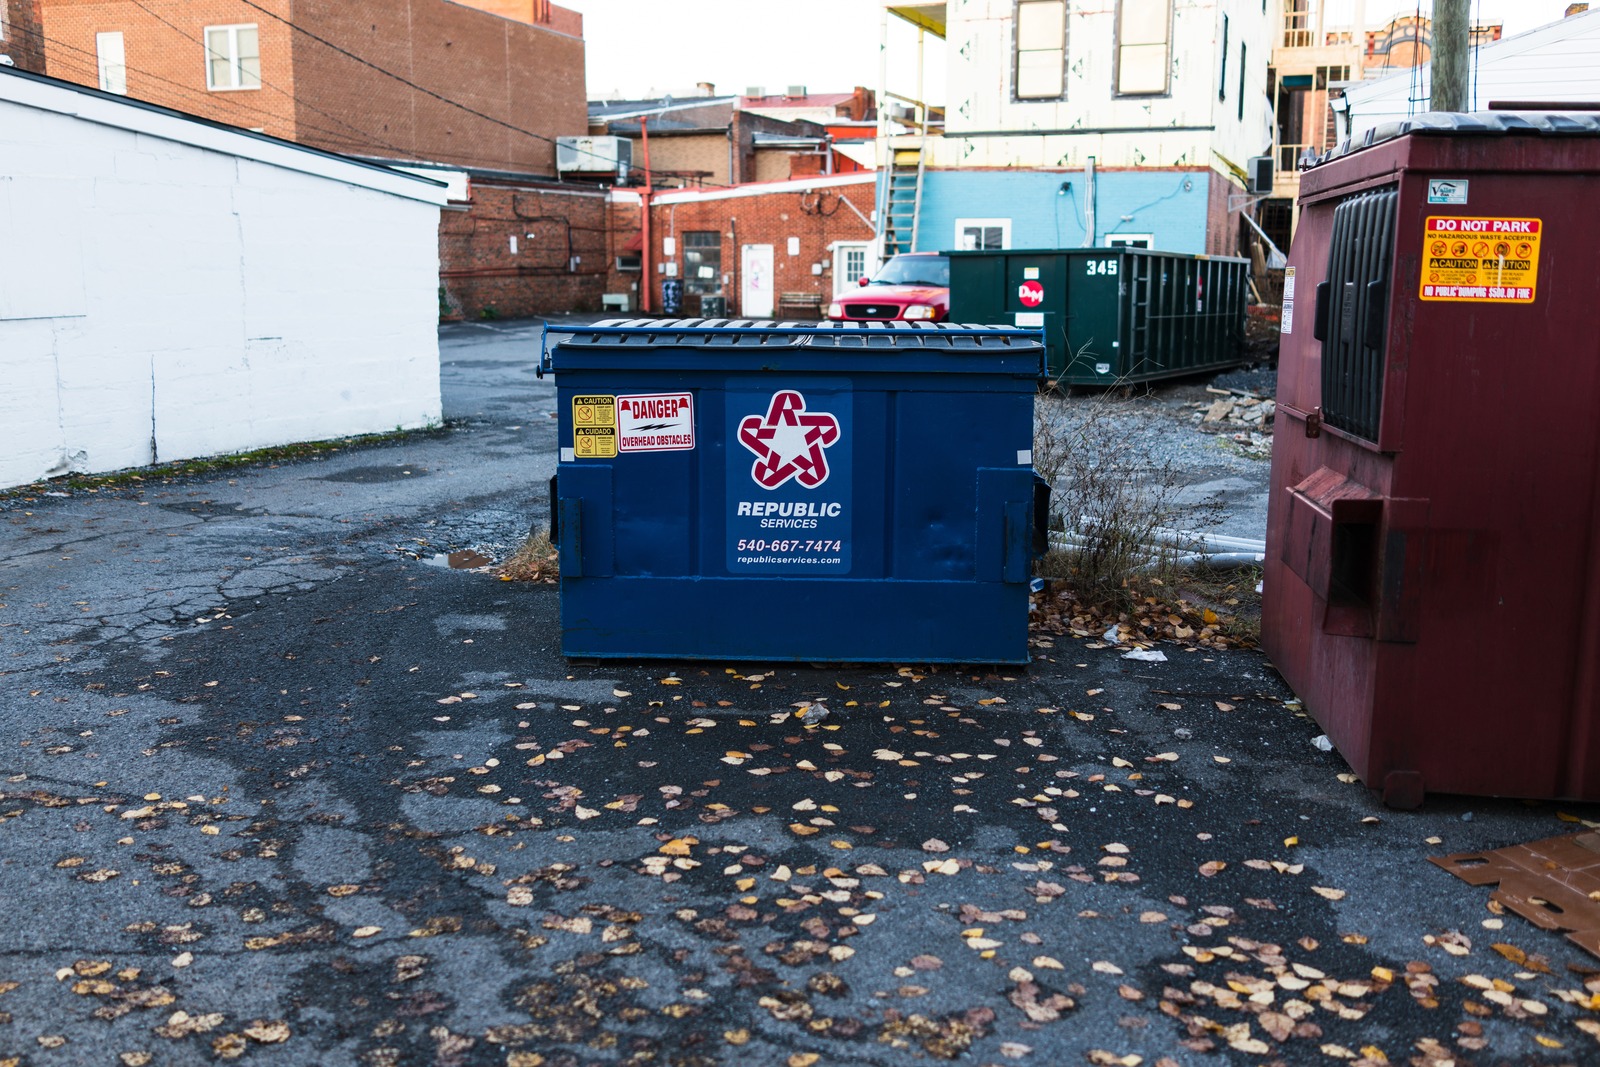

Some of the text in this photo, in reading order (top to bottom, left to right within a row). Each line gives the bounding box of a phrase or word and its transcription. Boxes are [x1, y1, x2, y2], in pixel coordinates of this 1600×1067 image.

[1436, 219, 1531, 232] DO NOT PARK
[1086, 260, 1118, 276] 345
[1439, 259, 1478, 269] CAUTION
[1424, 285, 1434, 297] NO
[1435, 286, 1457, 297] PUBLIC
[1457, 286, 1487, 298] DUMPING
[1516, 288, 1531, 299] FINE
[632, 399, 679, 420] DANGER
[622, 436, 656, 447] OVERHEAD
[656, 434, 692, 446] OBSTACLES
[737, 501, 842, 518] REPUBLIC
[760, 518, 818, 529] SERVICES
[737, 539, 841, 552] 540-667-7474
[737, 555, 841, 565] republicservices.com
